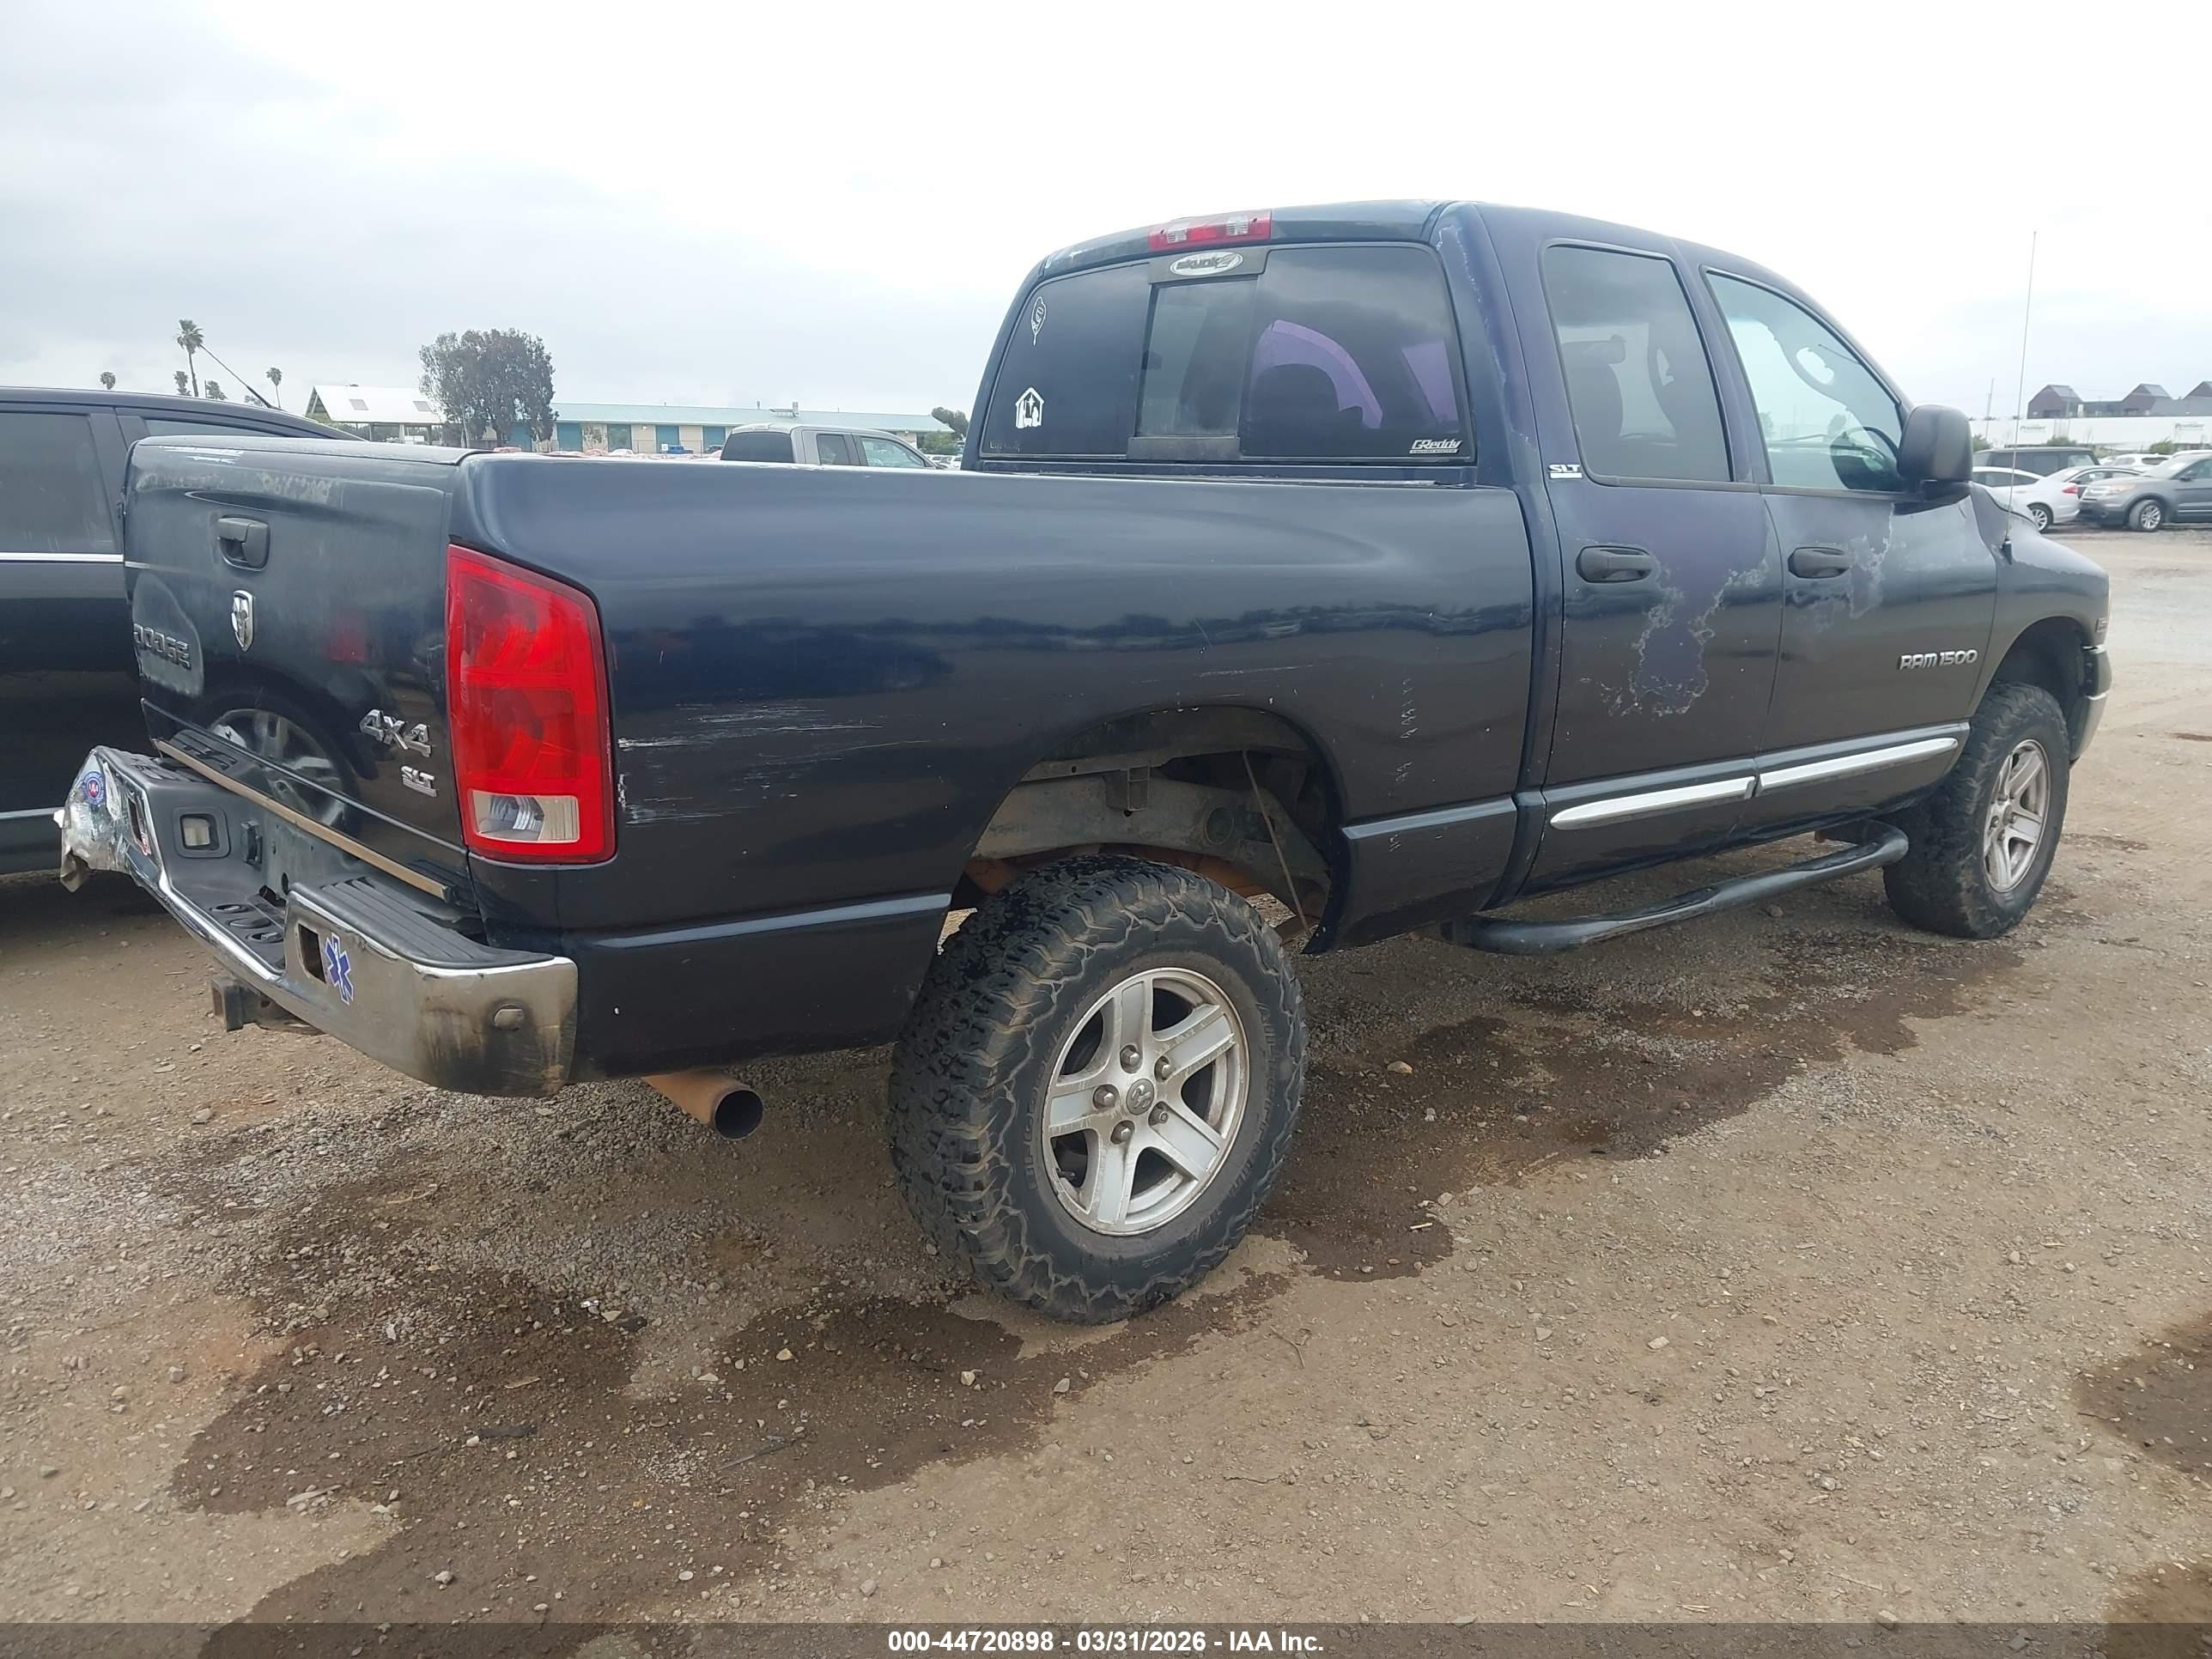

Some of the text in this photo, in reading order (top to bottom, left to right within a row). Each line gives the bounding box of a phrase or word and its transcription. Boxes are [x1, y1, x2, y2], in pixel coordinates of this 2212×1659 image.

[1411, 438, 1462, 450] GReddy
[1549, 464, 1580, 472] SLT
[133, 623, 190, 669] DODGE
[1899, 649, 1978, 671] RAM 1500
[400, 765, 435, 789] SLT
